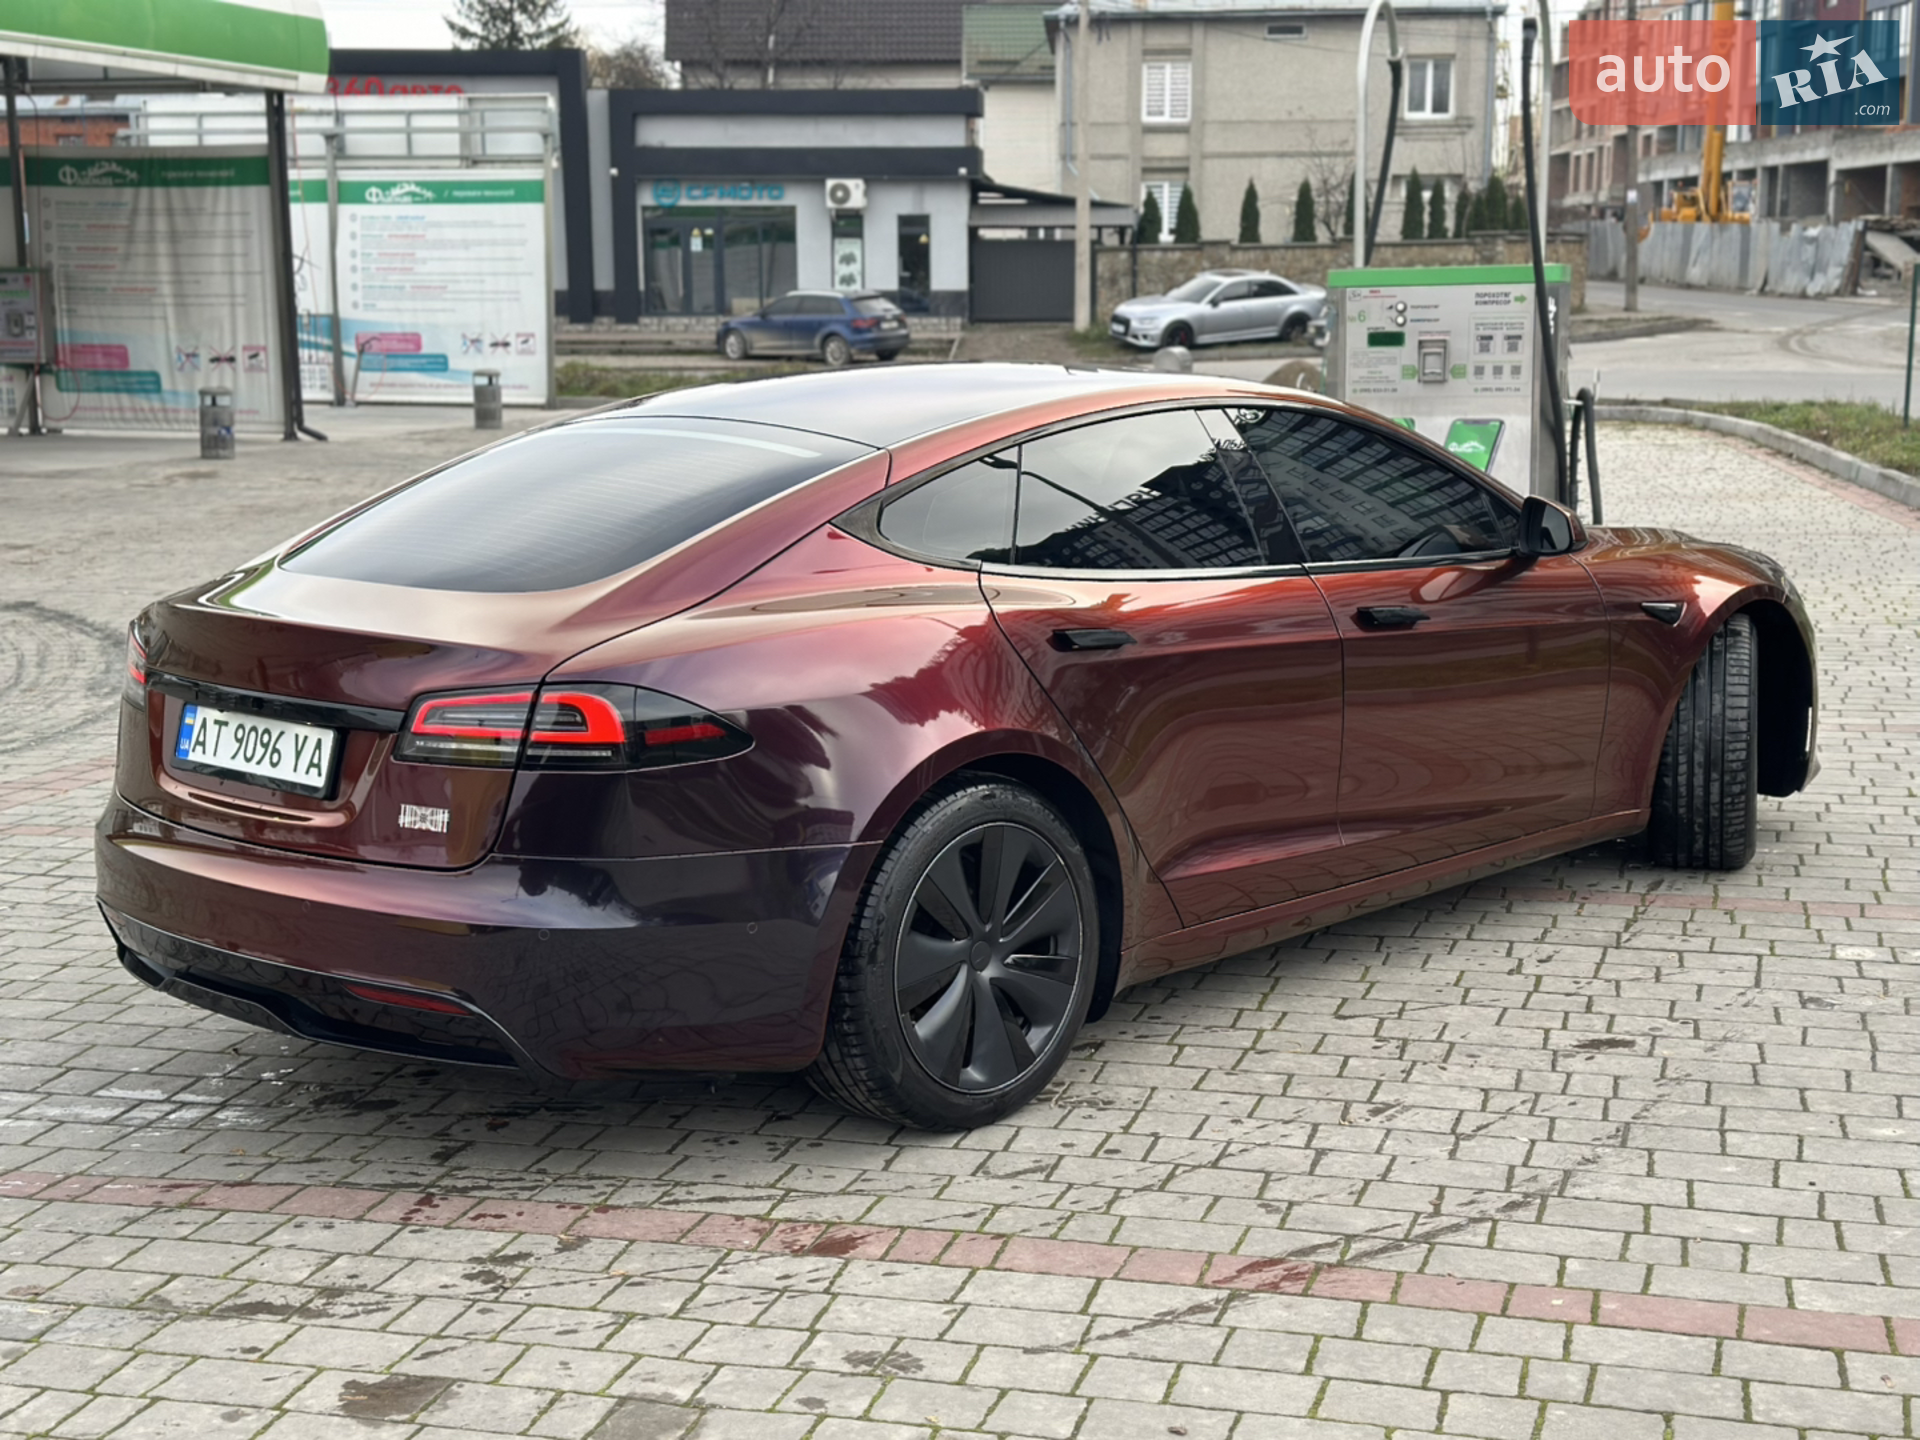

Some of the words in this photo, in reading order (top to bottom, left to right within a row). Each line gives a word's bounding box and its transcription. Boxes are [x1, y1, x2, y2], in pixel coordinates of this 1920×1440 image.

[685, 183, 785, 201] CFMOTO
[1358, 309, 1367, 323] 6
[180, 739, 190, 750] UA
[191, 716, 229, 757] AT
[230, 723, 285, 769] 9096
[293, 733, 322, 777] YA
